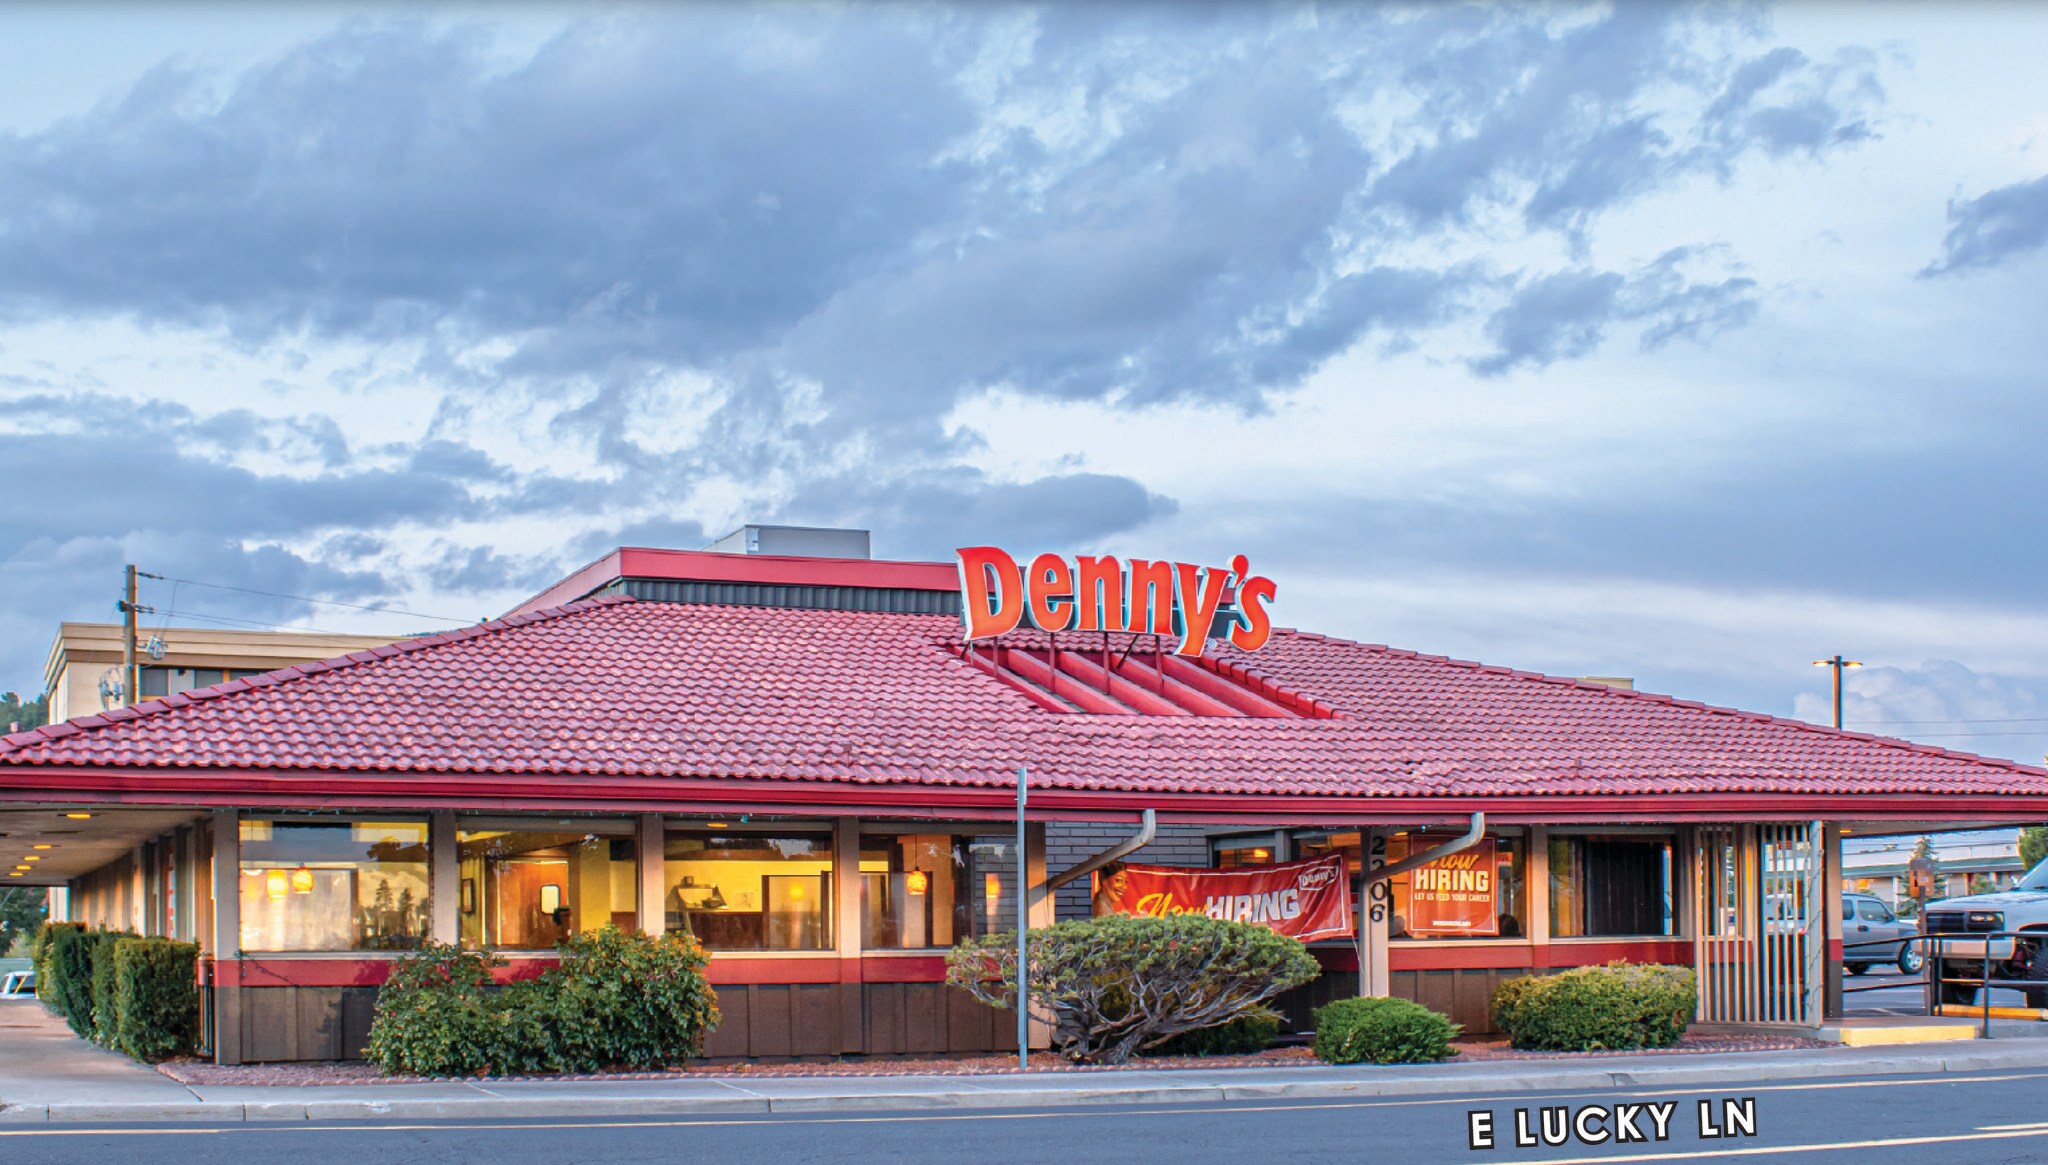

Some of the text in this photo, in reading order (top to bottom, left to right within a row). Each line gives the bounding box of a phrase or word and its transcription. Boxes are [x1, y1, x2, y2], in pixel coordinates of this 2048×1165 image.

[955, 546, 1277, 657] Denny's
[1415, 869, 1489, 892] HIRING
[1206, 889, 1300, 922] HIRING
[1427, 893, 1434, 901] US
